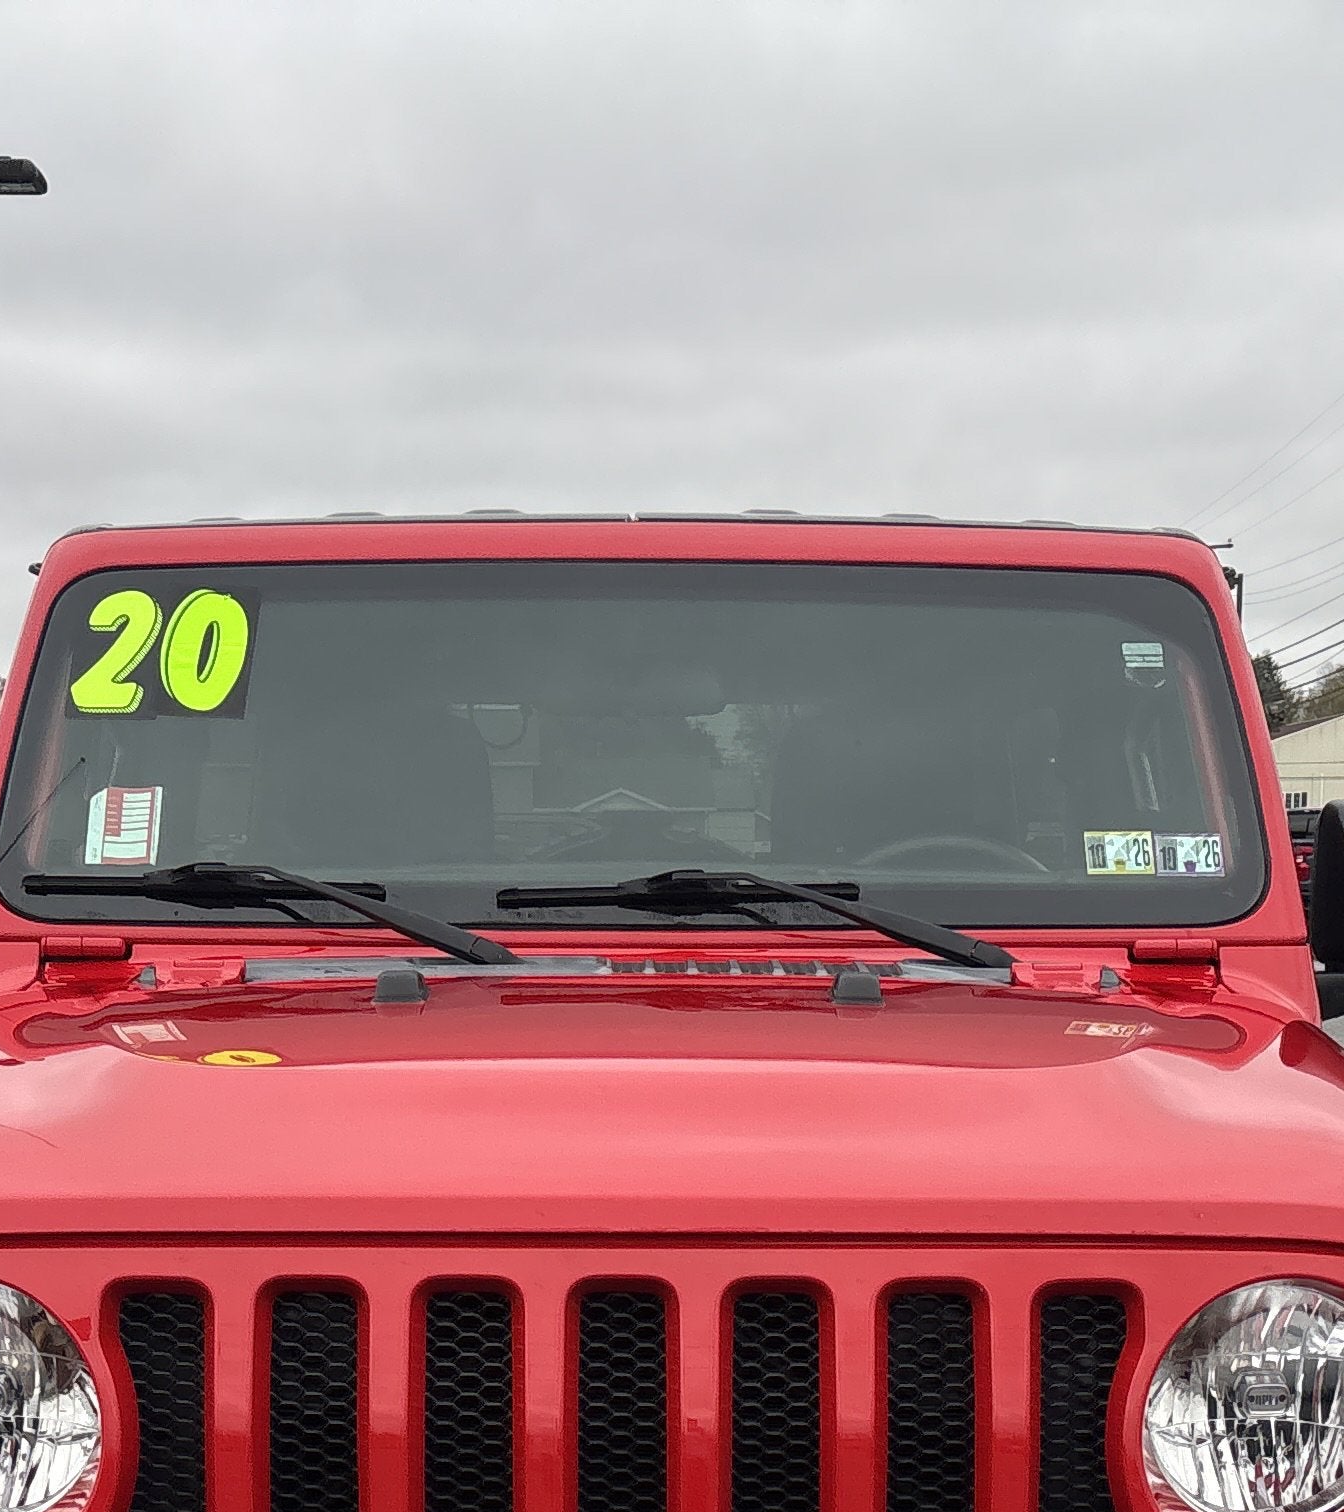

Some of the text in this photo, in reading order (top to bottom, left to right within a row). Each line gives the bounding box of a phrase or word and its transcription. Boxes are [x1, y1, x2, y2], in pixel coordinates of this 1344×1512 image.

[69, 586, 249, 714] 20
[1087, 838, 1151, 869] 10 26
[1159, 839, 1221, 871] 10 26
